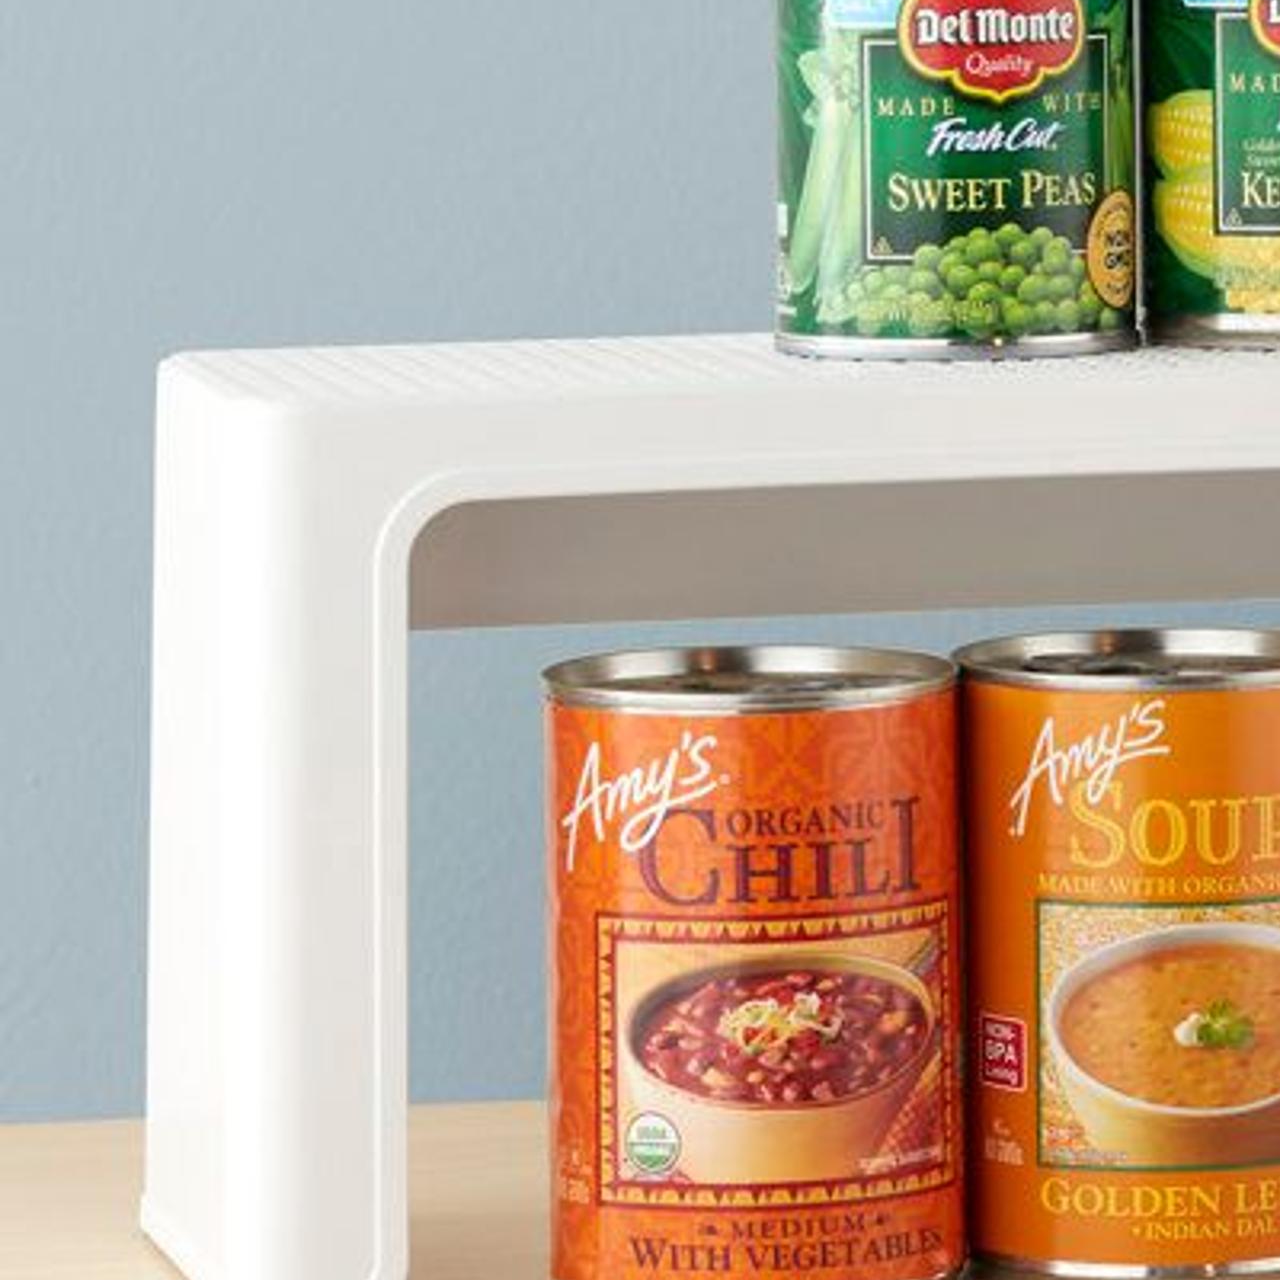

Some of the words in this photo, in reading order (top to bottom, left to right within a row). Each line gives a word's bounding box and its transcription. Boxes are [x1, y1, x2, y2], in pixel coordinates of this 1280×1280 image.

[916, 9, 968, 45] Del
[974, 8, 1076, 44] Monte
[965, 53, 1035, 77] Quality
[876, 96, 955, 117] MADE
[926, 117, 1001, 158] Fresh
[889, 172, 1012, 212] SWEET
[1021, 169, 1095, 207] PEAS
[1010, 699, 1171, 837] Amy's
[562, 731, 718, 872] Amy's
[726, 800, 885, 838] ORGANIC
[637, 795, 921, 908] CHILI
[1037, 873, 1099, 894] MADE
[1101, 876, 1176, 895] WITH
[1039, 1176, 1221, 1218] GOLDEN
[731, 1214, 867, 1240] MEDIUM
[1144, 1219, 1230, 1240] INDIAN
[1237, 1217, 1279, 1237] DAL
[629, 1236, 731, 1272] WITH
[744, 1227, 942, 1272] VEGETABLES
